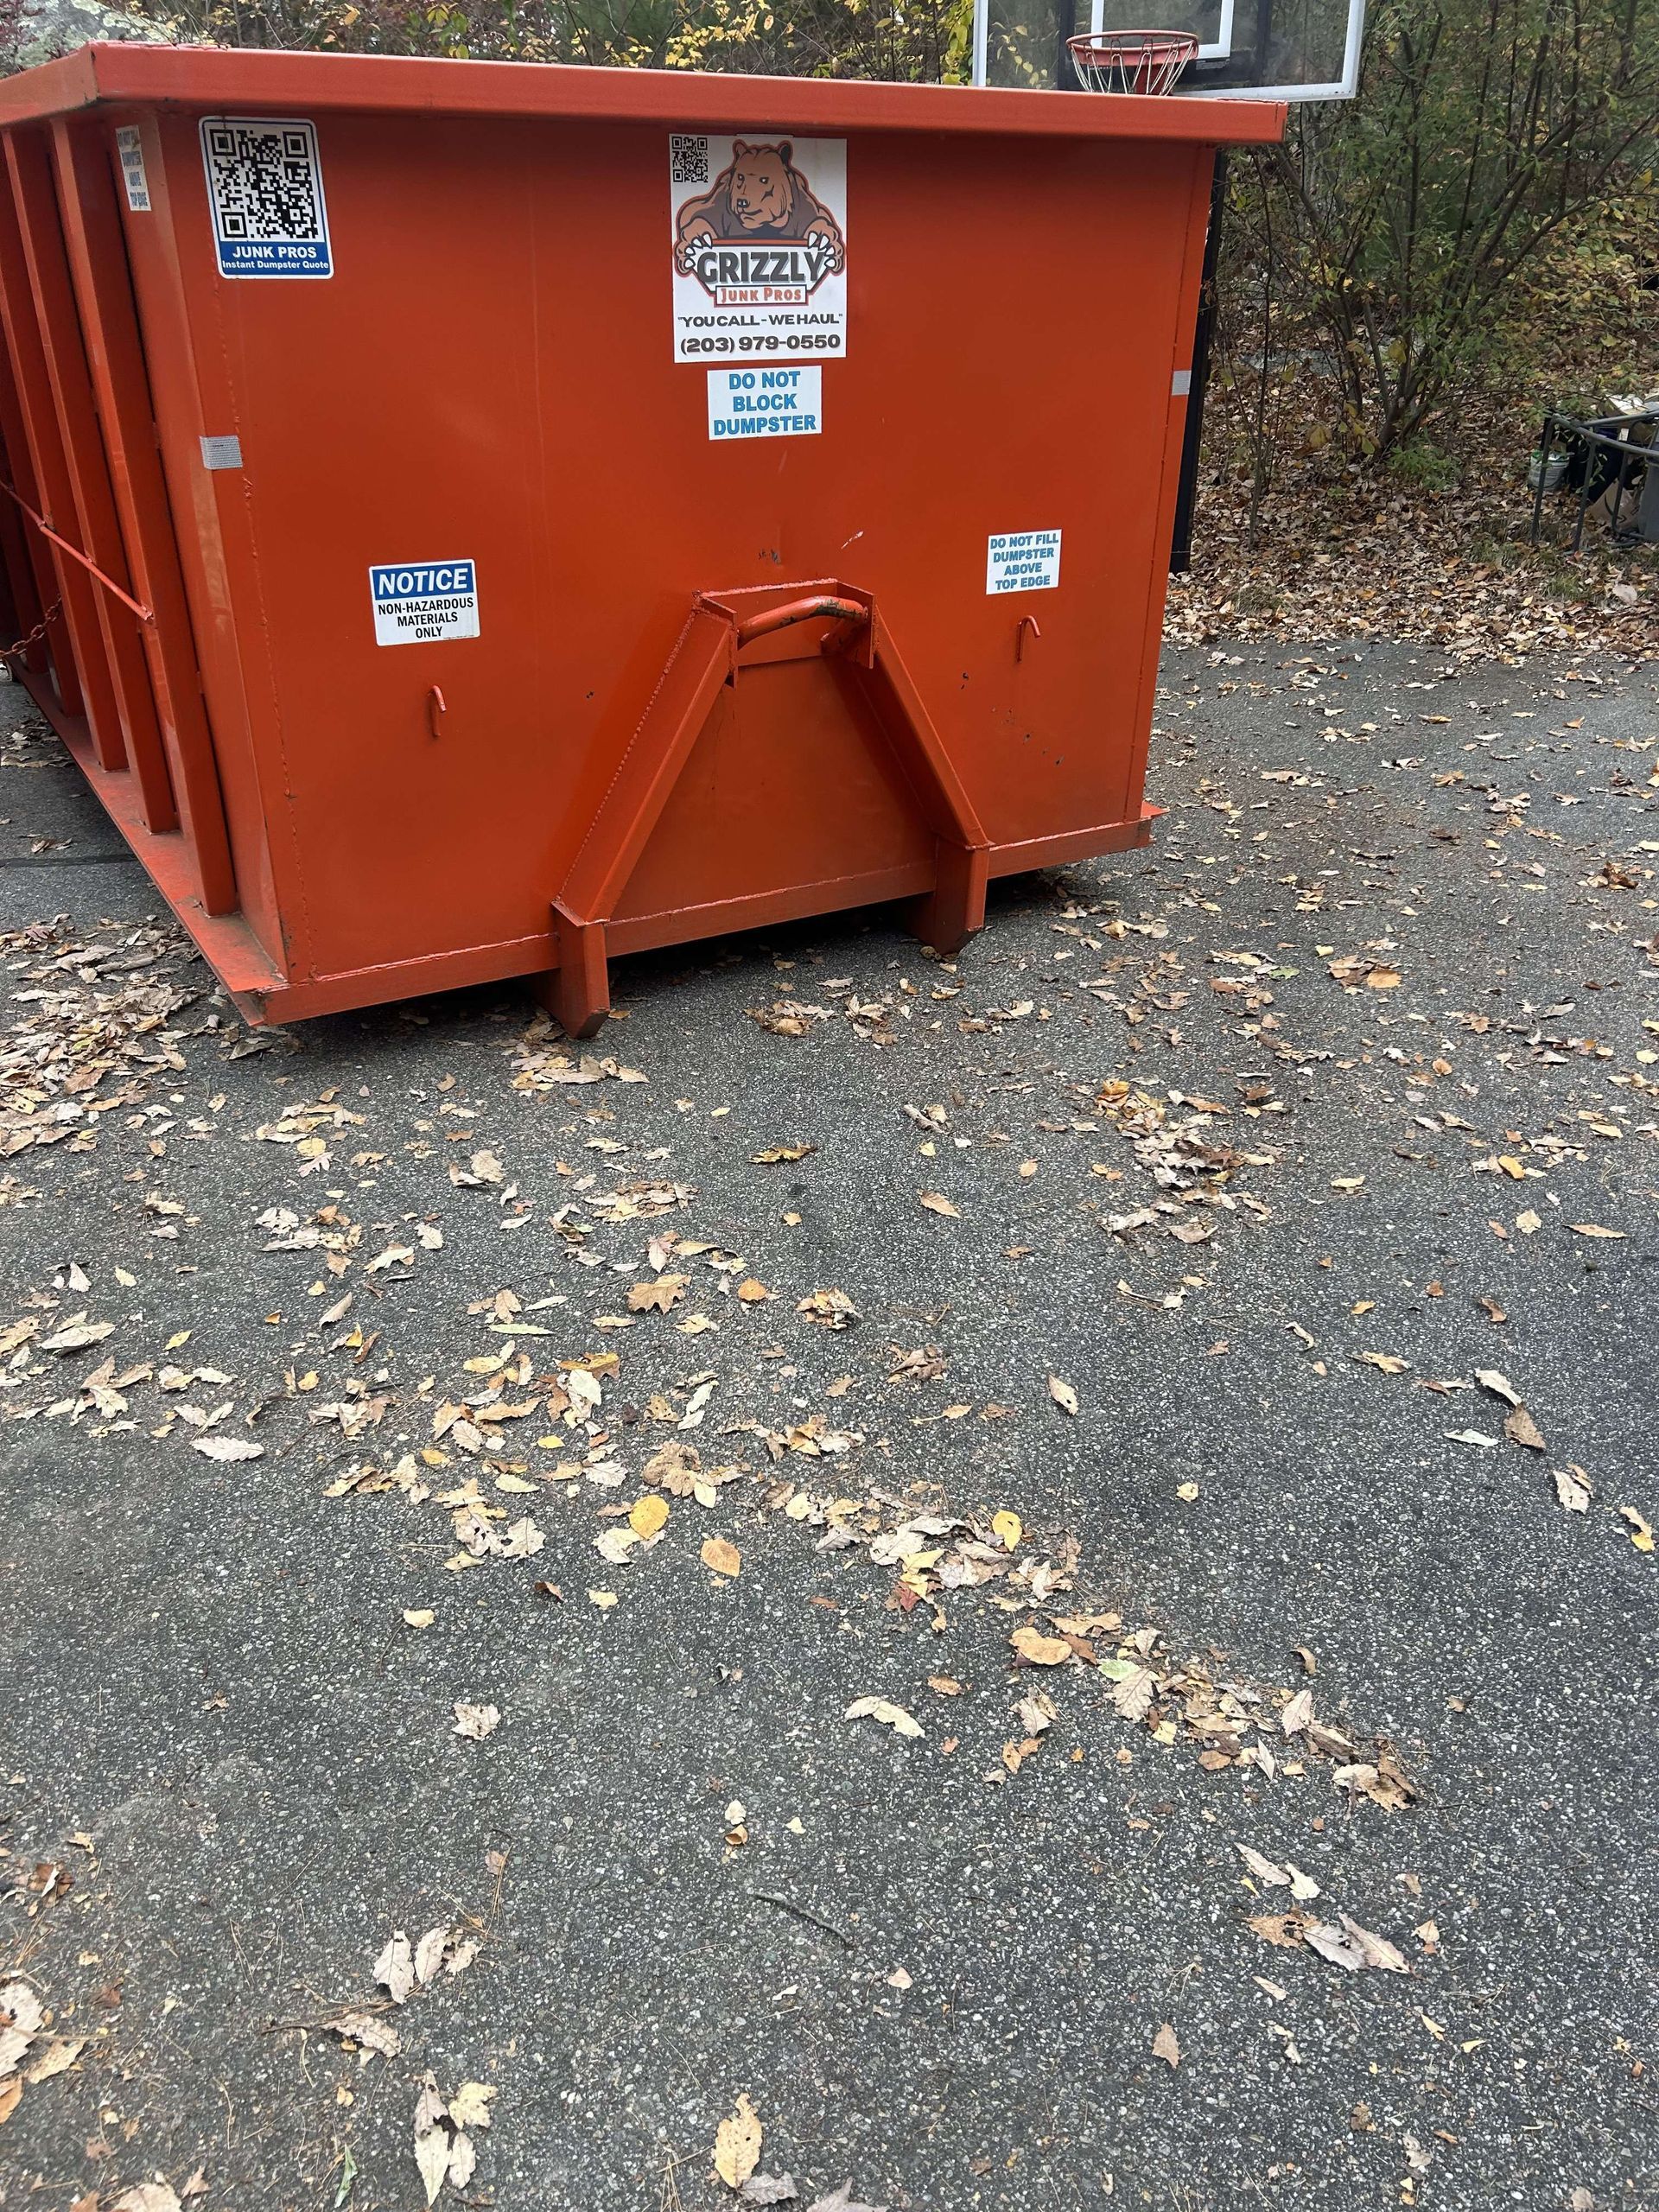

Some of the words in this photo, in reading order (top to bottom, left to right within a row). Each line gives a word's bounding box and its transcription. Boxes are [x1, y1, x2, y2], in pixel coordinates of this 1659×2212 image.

[232, 246, 275, 258] JUNK
[277, 246, 317, 258] PROS
[222, 260, 255, 269] Instant
[257, 260, 300, 270] Dumpster
[302, 260, 329, 269] Quote
[696, 251, 823, 283] GRIZZLY
[681, 337, 735, 355] (203)
[739, 334, 841, 351] 979-0550
[728, 373, 755, 390] DO
[761, 371, 801, 388] NOT
[733, 393, 798, 412] BLOCK
[714, 415, 817, 435] DUMPSTER
[990, 537, 1007, 550] DO
[1009, 535, 1033, 548] NOT
[1035, 533, 1058, 545] FILL
[993, 547, 1054, 563] DUMPSTER
[1004, 563, 1043, 576] ABOVE
[378, 568, 468, 595] NOTICE
[995, 578, 1018, 590] TOP
[1020, 575, 1051, 588] EDGE
[378, 597, 474, 615] NON-HAZARDOUS
[397, 612, 458, 627] MATERIALS
[416, 626, 442, 639] ONLY
